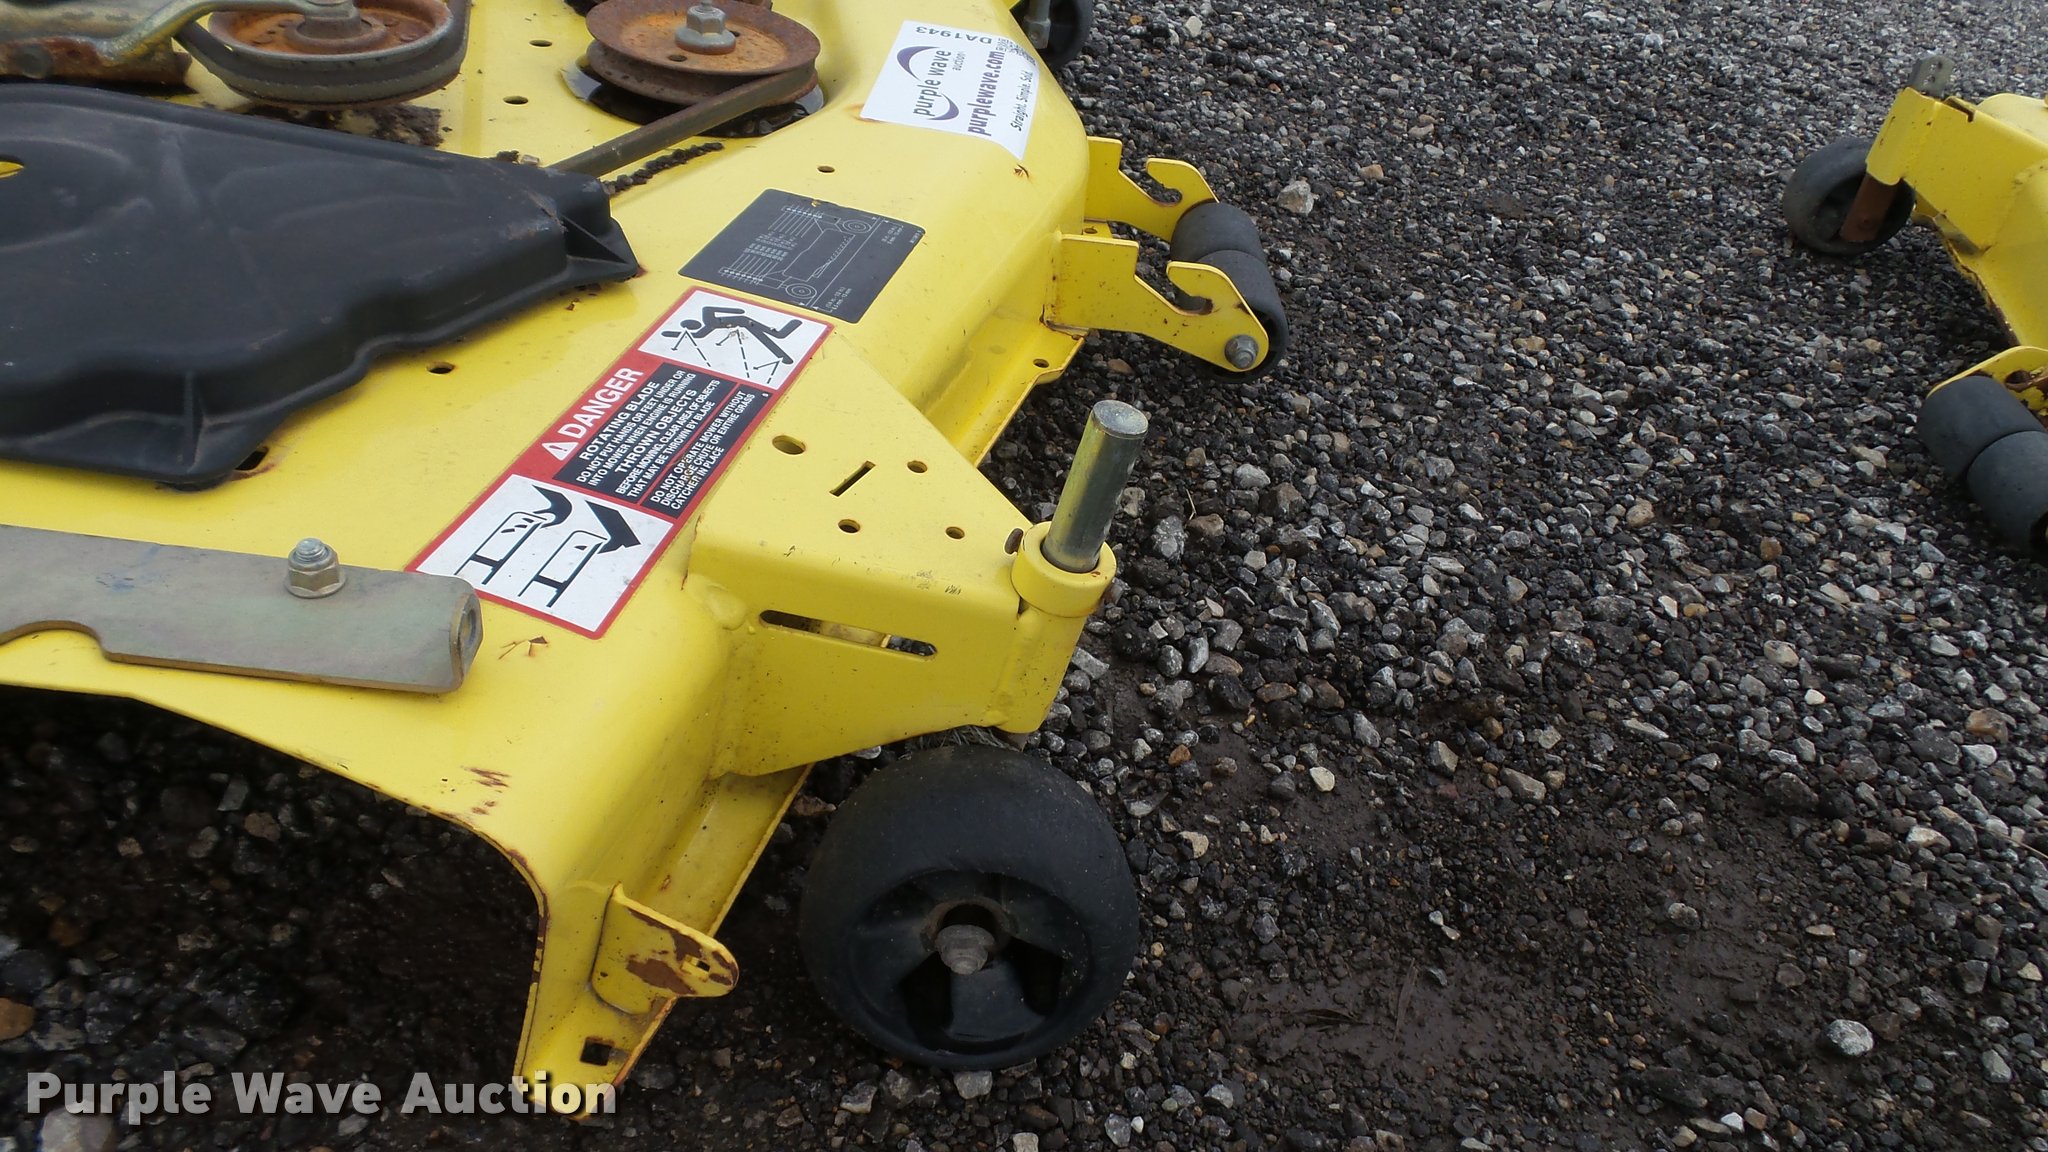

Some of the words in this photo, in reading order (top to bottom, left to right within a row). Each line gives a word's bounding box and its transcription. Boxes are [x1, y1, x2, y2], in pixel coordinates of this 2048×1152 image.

[916, 26, 992, 45] DA1943
[927, 50, 951, 76] wave
[913, 79, 942, 117] purple
[967, 51, 1005, 136] purplewave.com
[557, 368, 644, 439] DANGER
[576, 470, 591, 482] DO
[587, 456, 604, 472] NOT
[600, 442, 616, 457] PUT
[611, 421, 636, 444] HANDS
[632, 412, 646, 423] OR
[641, 397, 659, 413] FEET
[656, 378, 674, 398] UNDER
[673, 370, 686, 380] OR
[579, 412, 631, 460] ROTATING
[625, 381, 660, 411] BLADE
[588, 468, 608, 486] INTO
[605, 443, 629, 469] MOWER
[625, 425, 648, 444] WHEN
[642, 403, 668, 427] ENGINE
[662, 396, 673, 405] IS
[669, 373, 696, 398] RUNNING
[615, 430, 661, 473] THROWN
[655, 389, 697, 430] OBJECTS
[615, 467, 643, 494] BEFORE
[660, 424, 680, 444] CLEAR
[676, 409, 694, 427] AREA
[688, 402, 701, 412] OF
[695, 379, 720, 404] OBJECTS
[627, 478, 648, 498] THAT
[642, 463, 661, 480] MAY
[654, 454, 669, 465] BE
[663, 428, 692, 455] THROWN
[686, 417, 699, 429] BY
[696, 400, 715, 420] BLADE
[650, 490, 665, 503] DO
[660, 473, 678, 490] NOT
[699, 417, 724, 443] MOWER
[719, 390, 746, 418] WITHOUT
[660, 464, 698, 506] DISCHARGE
[693, 443, 715, 466] CHUTE
[710, 434, 722, 445] OR
[720, 413, 740, 435] ENTIRE
[734, 393, 755, 414] GRASS
[670, 475, 702, 510] CATCHER
[697, 466, 708, 477] IN
[703, 445, 725, 469] PLACE
